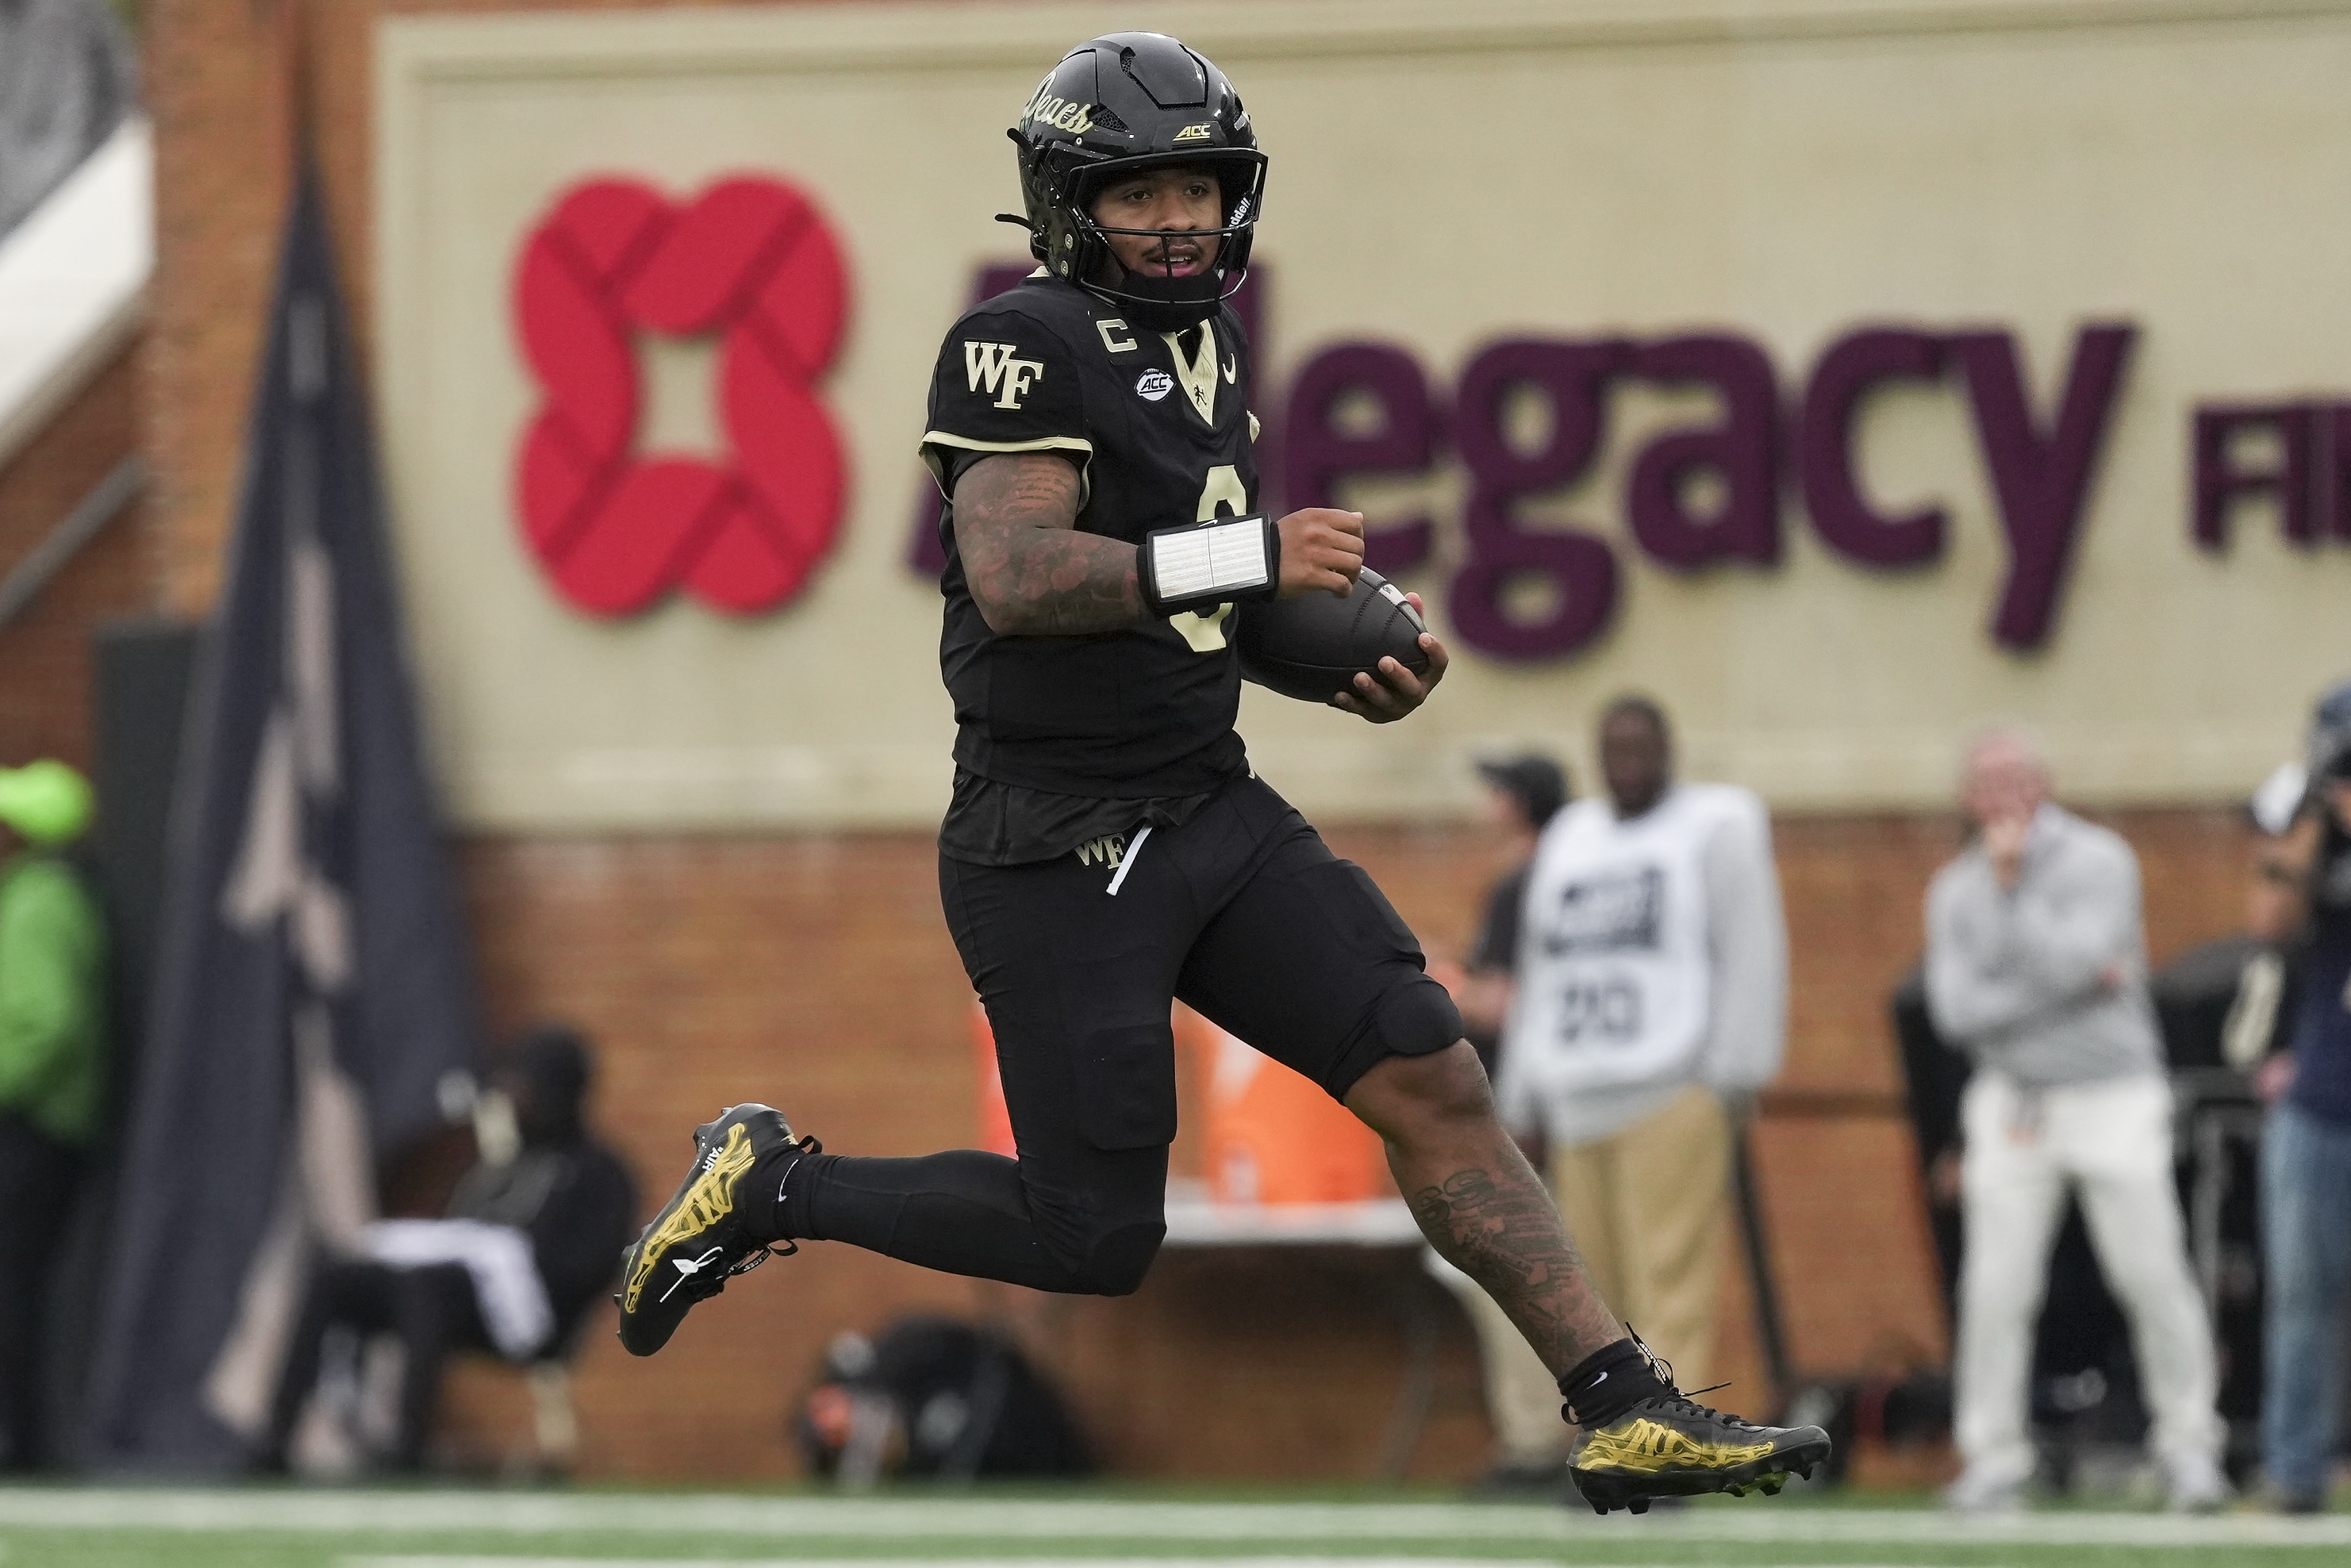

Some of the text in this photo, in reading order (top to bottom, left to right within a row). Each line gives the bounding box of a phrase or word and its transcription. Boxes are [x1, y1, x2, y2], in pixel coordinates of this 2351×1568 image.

[1174, 125, 1211, 140] ACC
[1096, 318, 1138, 353] C
[964, 341, 1044, 409] WF
[1140, 375, 1170, 394] ACC
[1074, 833, 1126, 870] WF
